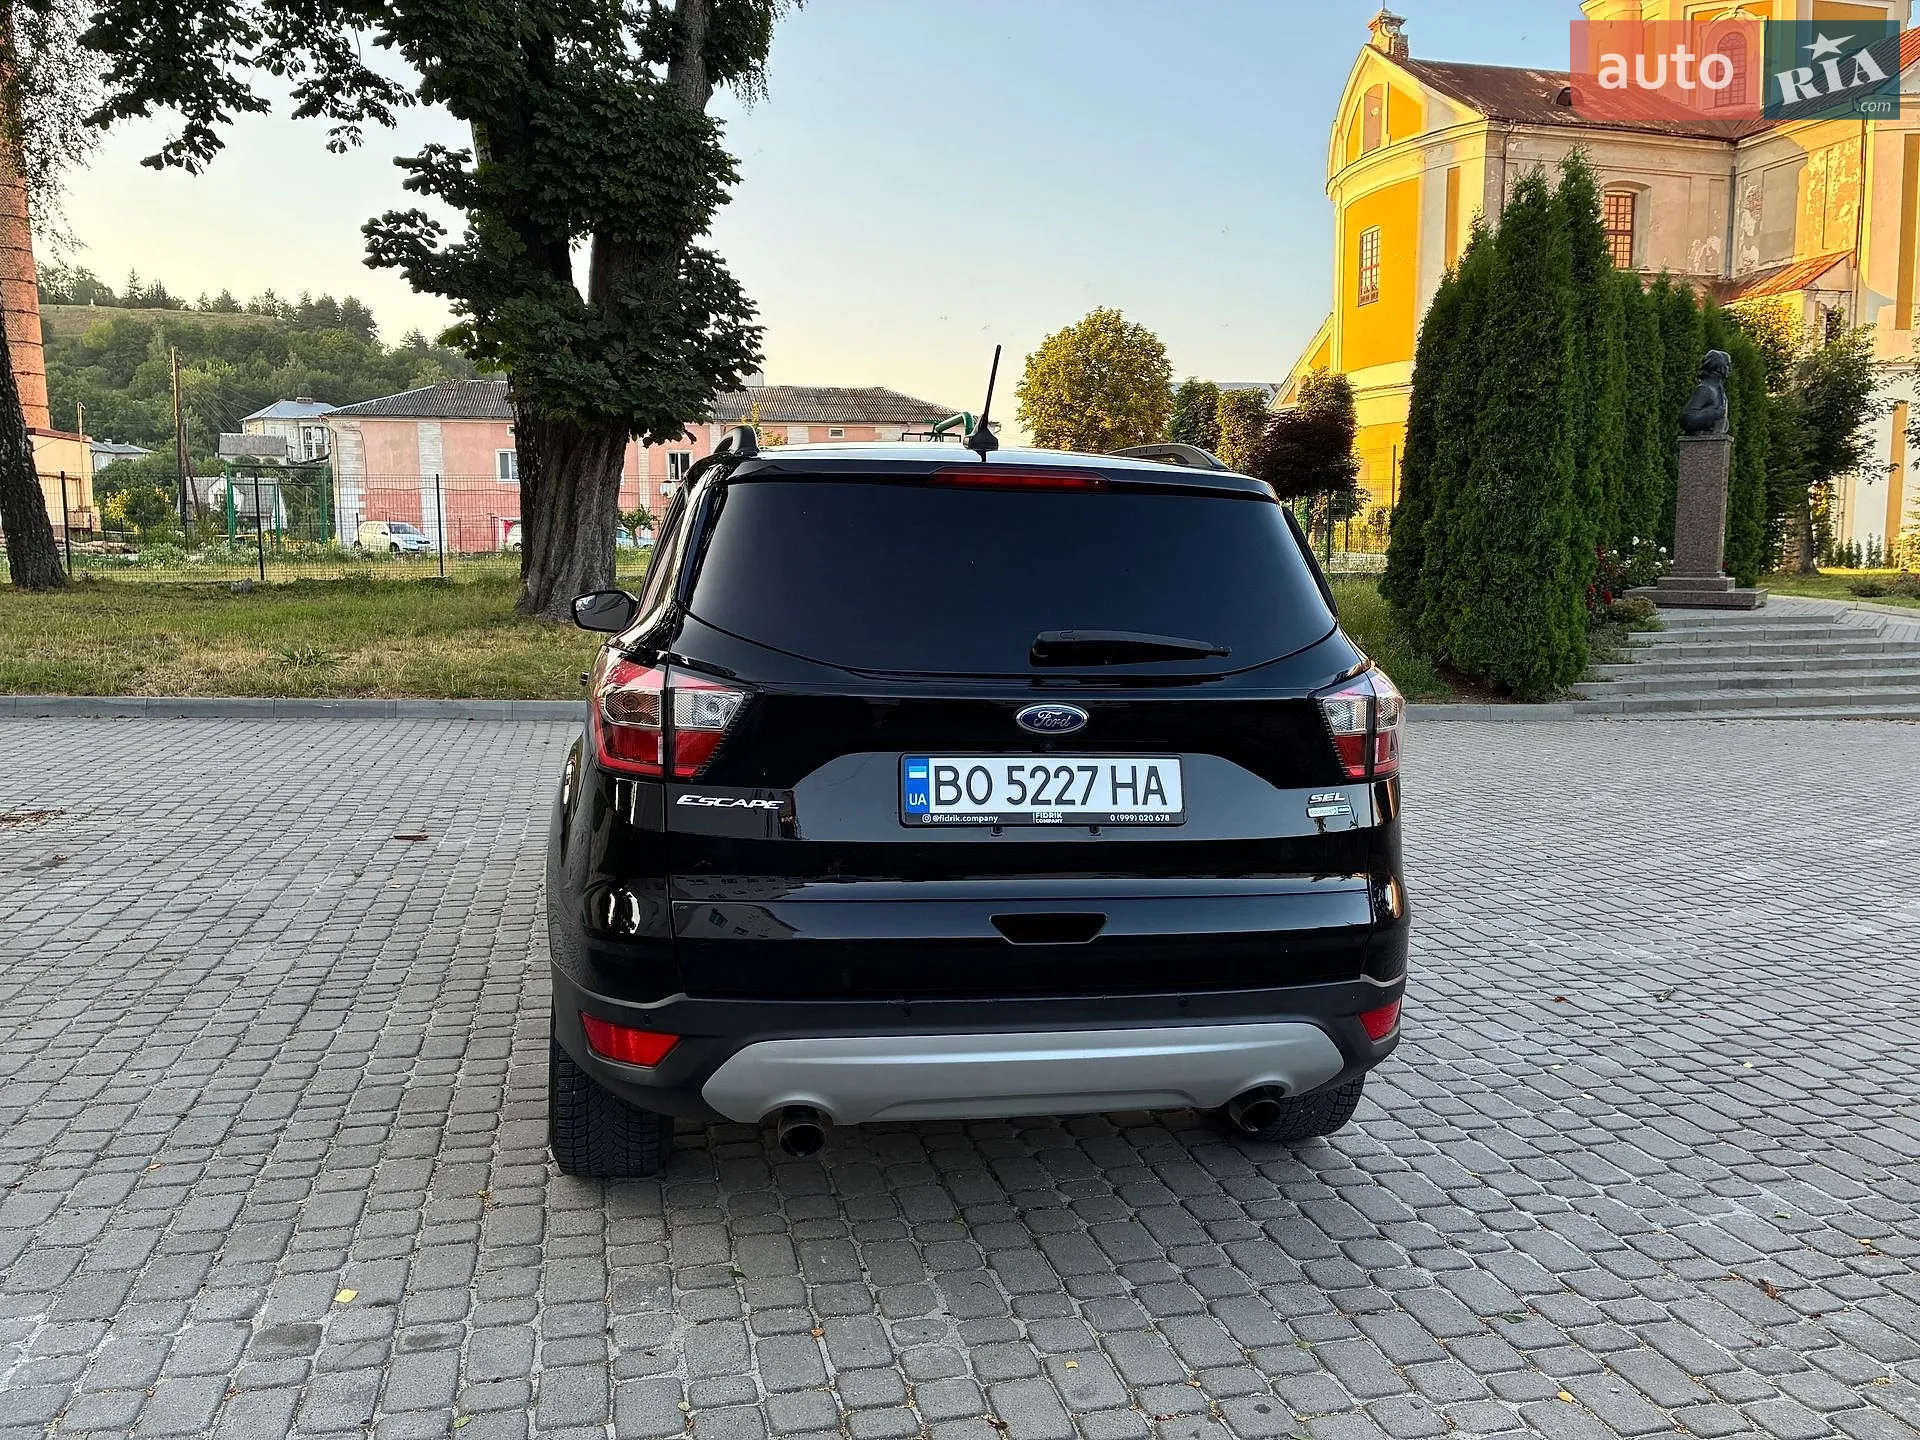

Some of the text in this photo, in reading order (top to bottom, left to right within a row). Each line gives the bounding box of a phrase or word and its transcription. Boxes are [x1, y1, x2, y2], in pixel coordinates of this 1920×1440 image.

[1033, 710, 1072, 727] Ford
[934, 765, 1168, 805] BO 5227 HA
[676, 794, 785, 810] ESCAPE
[909, 793, 928, 806] UA
[1309, 792, 1346, 804] SEL
[932, 813, 999, 824] @fidrik.company
[1036, 811, 1063, 819] FIDRIK
[1138, 814, 1153, 822] 020
[1154, 814, 1170, 822] 678
